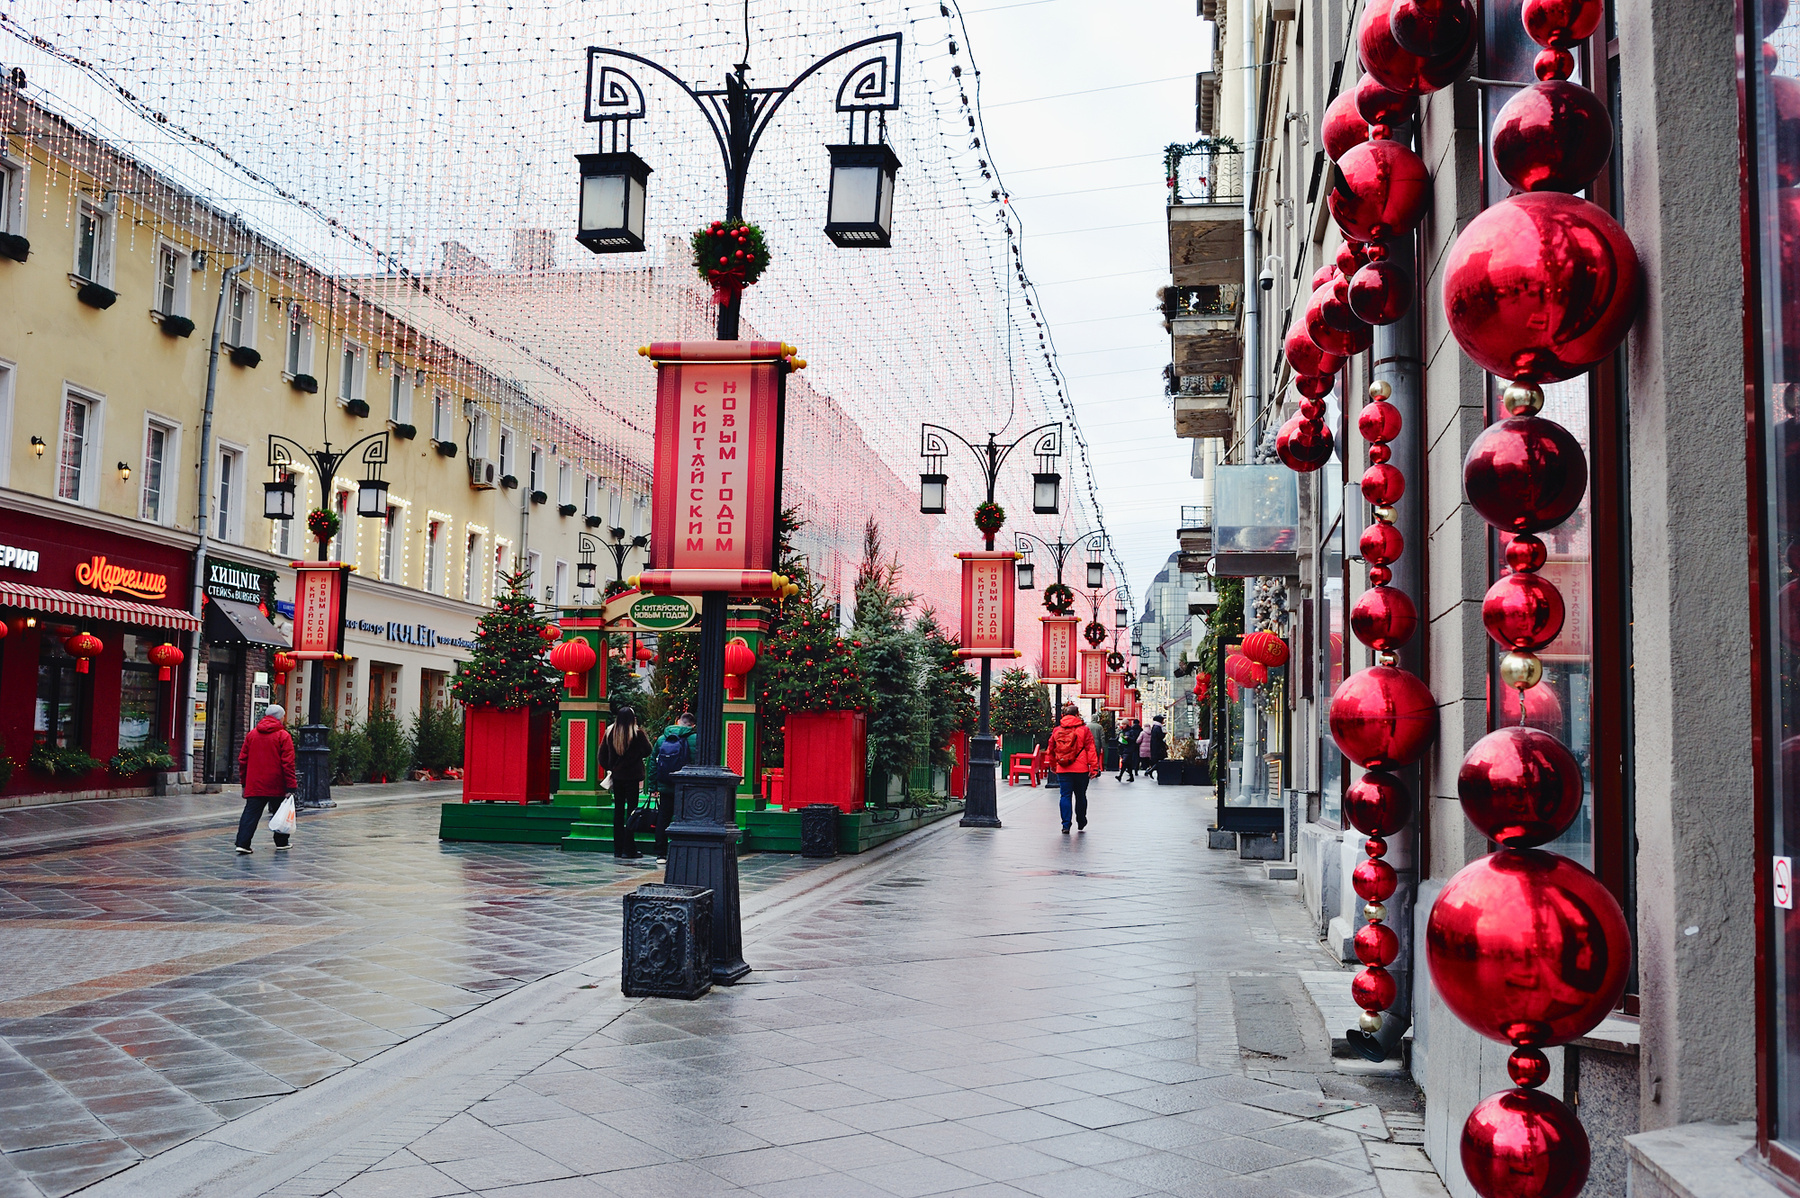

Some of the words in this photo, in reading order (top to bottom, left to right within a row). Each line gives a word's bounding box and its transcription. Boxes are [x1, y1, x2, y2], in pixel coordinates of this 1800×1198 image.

[694, 382, 708, 394] С
[719, 381, 737, 460] НОВЫМ
[686, 404, 707, 552] КИТАЙСКИМ
[716, 471, 734, 552] ГОДОМ
[76, 556, 168, 600] Марчеллис
[318, 577, 327, 609] НОВЫМ
[989, 567, 998, 601] НОВЫМ
[305, 586, 316, 645] КИТАЙСКИМ
[634, 611, 661, 619] НОВЫМ
[662, 612, 689, 620] ГОДОМ
[642, 603, 689, 612] КИТАЙСКИМ
[976, 577, 985, 641] КИТАЙСКИМ
[989, 605, 998, 641] ГОДОМ
[316, 613, 325, 645] ГОДОМ
